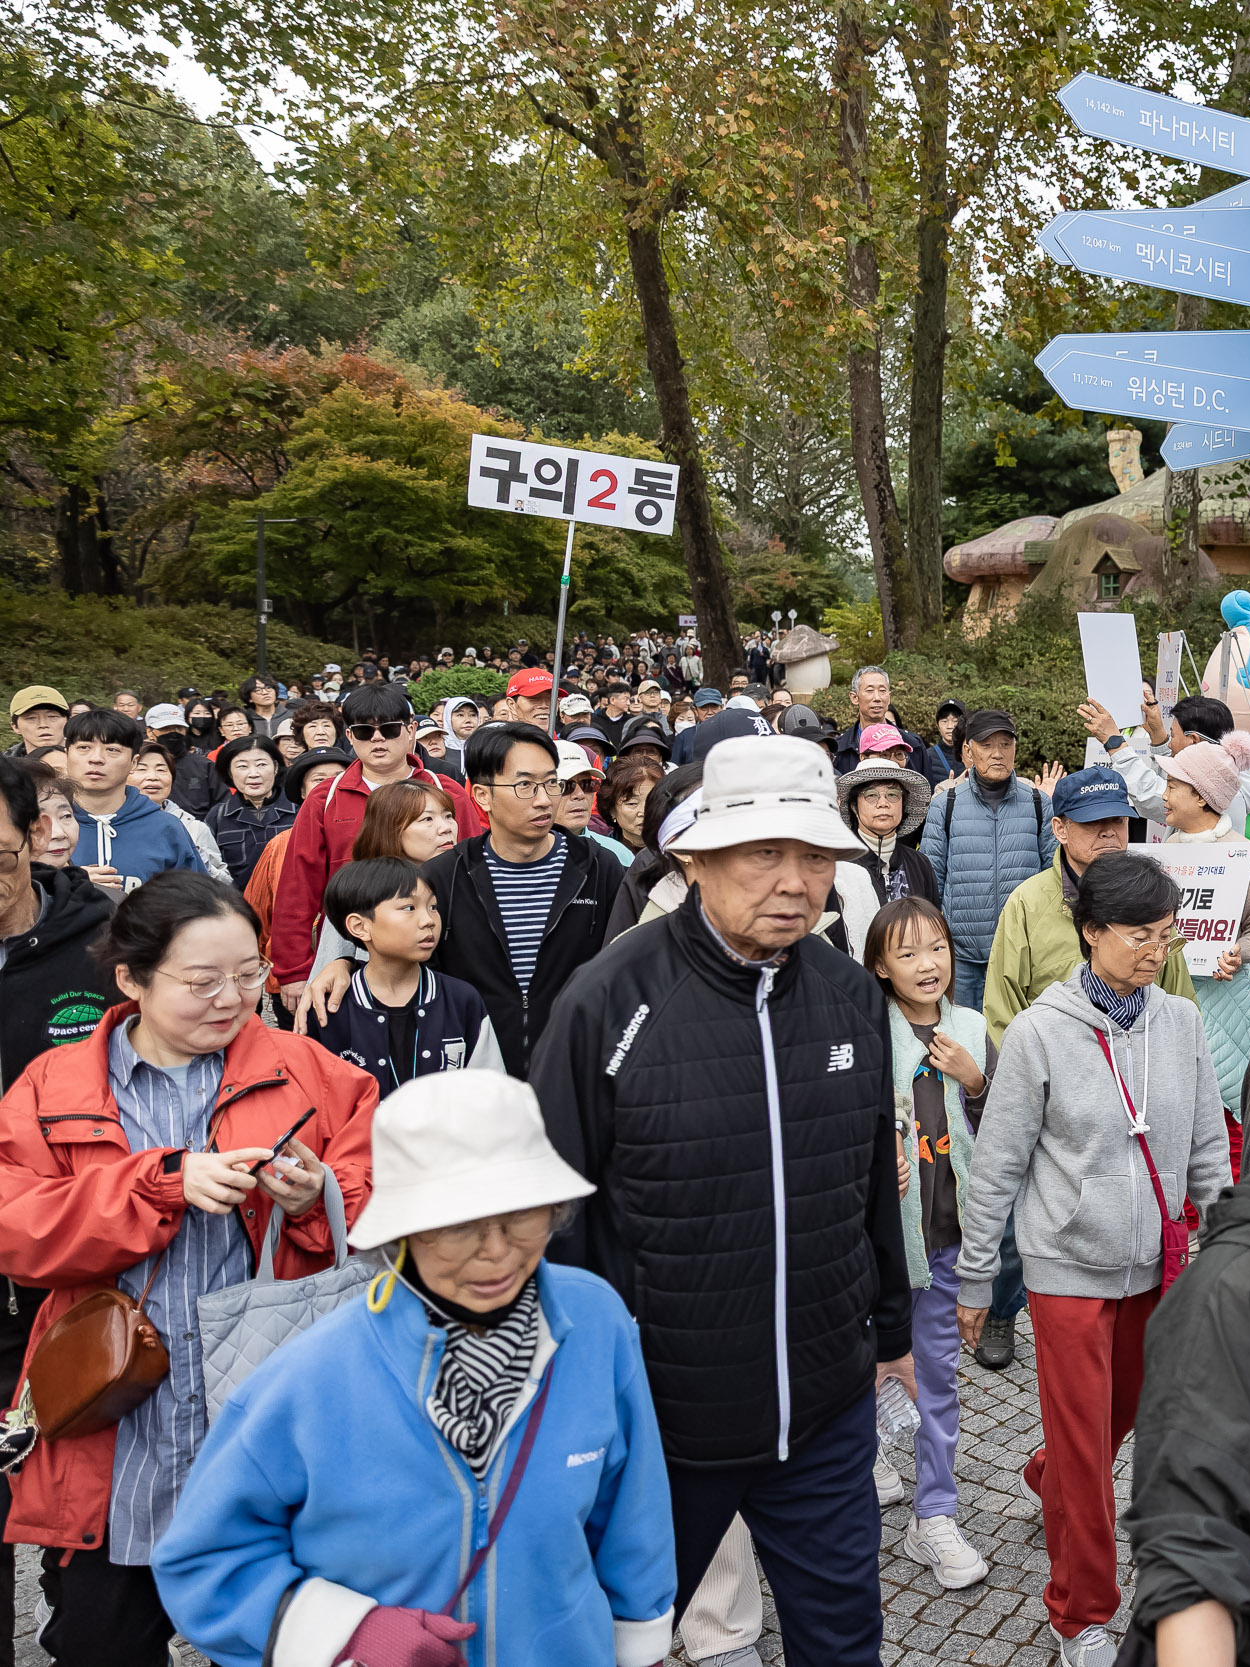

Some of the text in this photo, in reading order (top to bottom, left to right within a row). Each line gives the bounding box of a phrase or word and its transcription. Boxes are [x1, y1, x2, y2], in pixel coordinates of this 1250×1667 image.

[1085, 98, 1125, 118] 14,142 km
[1139, 109, 1235, 157] 파나마시티
[1082, 235, 1122, 253] 12,047 km
[1136, 242, 1231, 287] 멕시코시티
[1072, 373, 1113, 388] 11,172 km
[1127, 376, 1230, 413] 워싱턴 D.C.
[1202, 429, 1235, 451] 시드니
[479, 446, 675, 527] 구의2동
[1080, 783, 1119, 794] SPORWORLD
[1174, 866, 1195, 876] 가을길
[1197, 866, 1226, 876] 걷기대회
[50, 993, 69, 1005] Build
[84, 991, 105, 1001] Space
[48, 1026, 78, 1036] space
